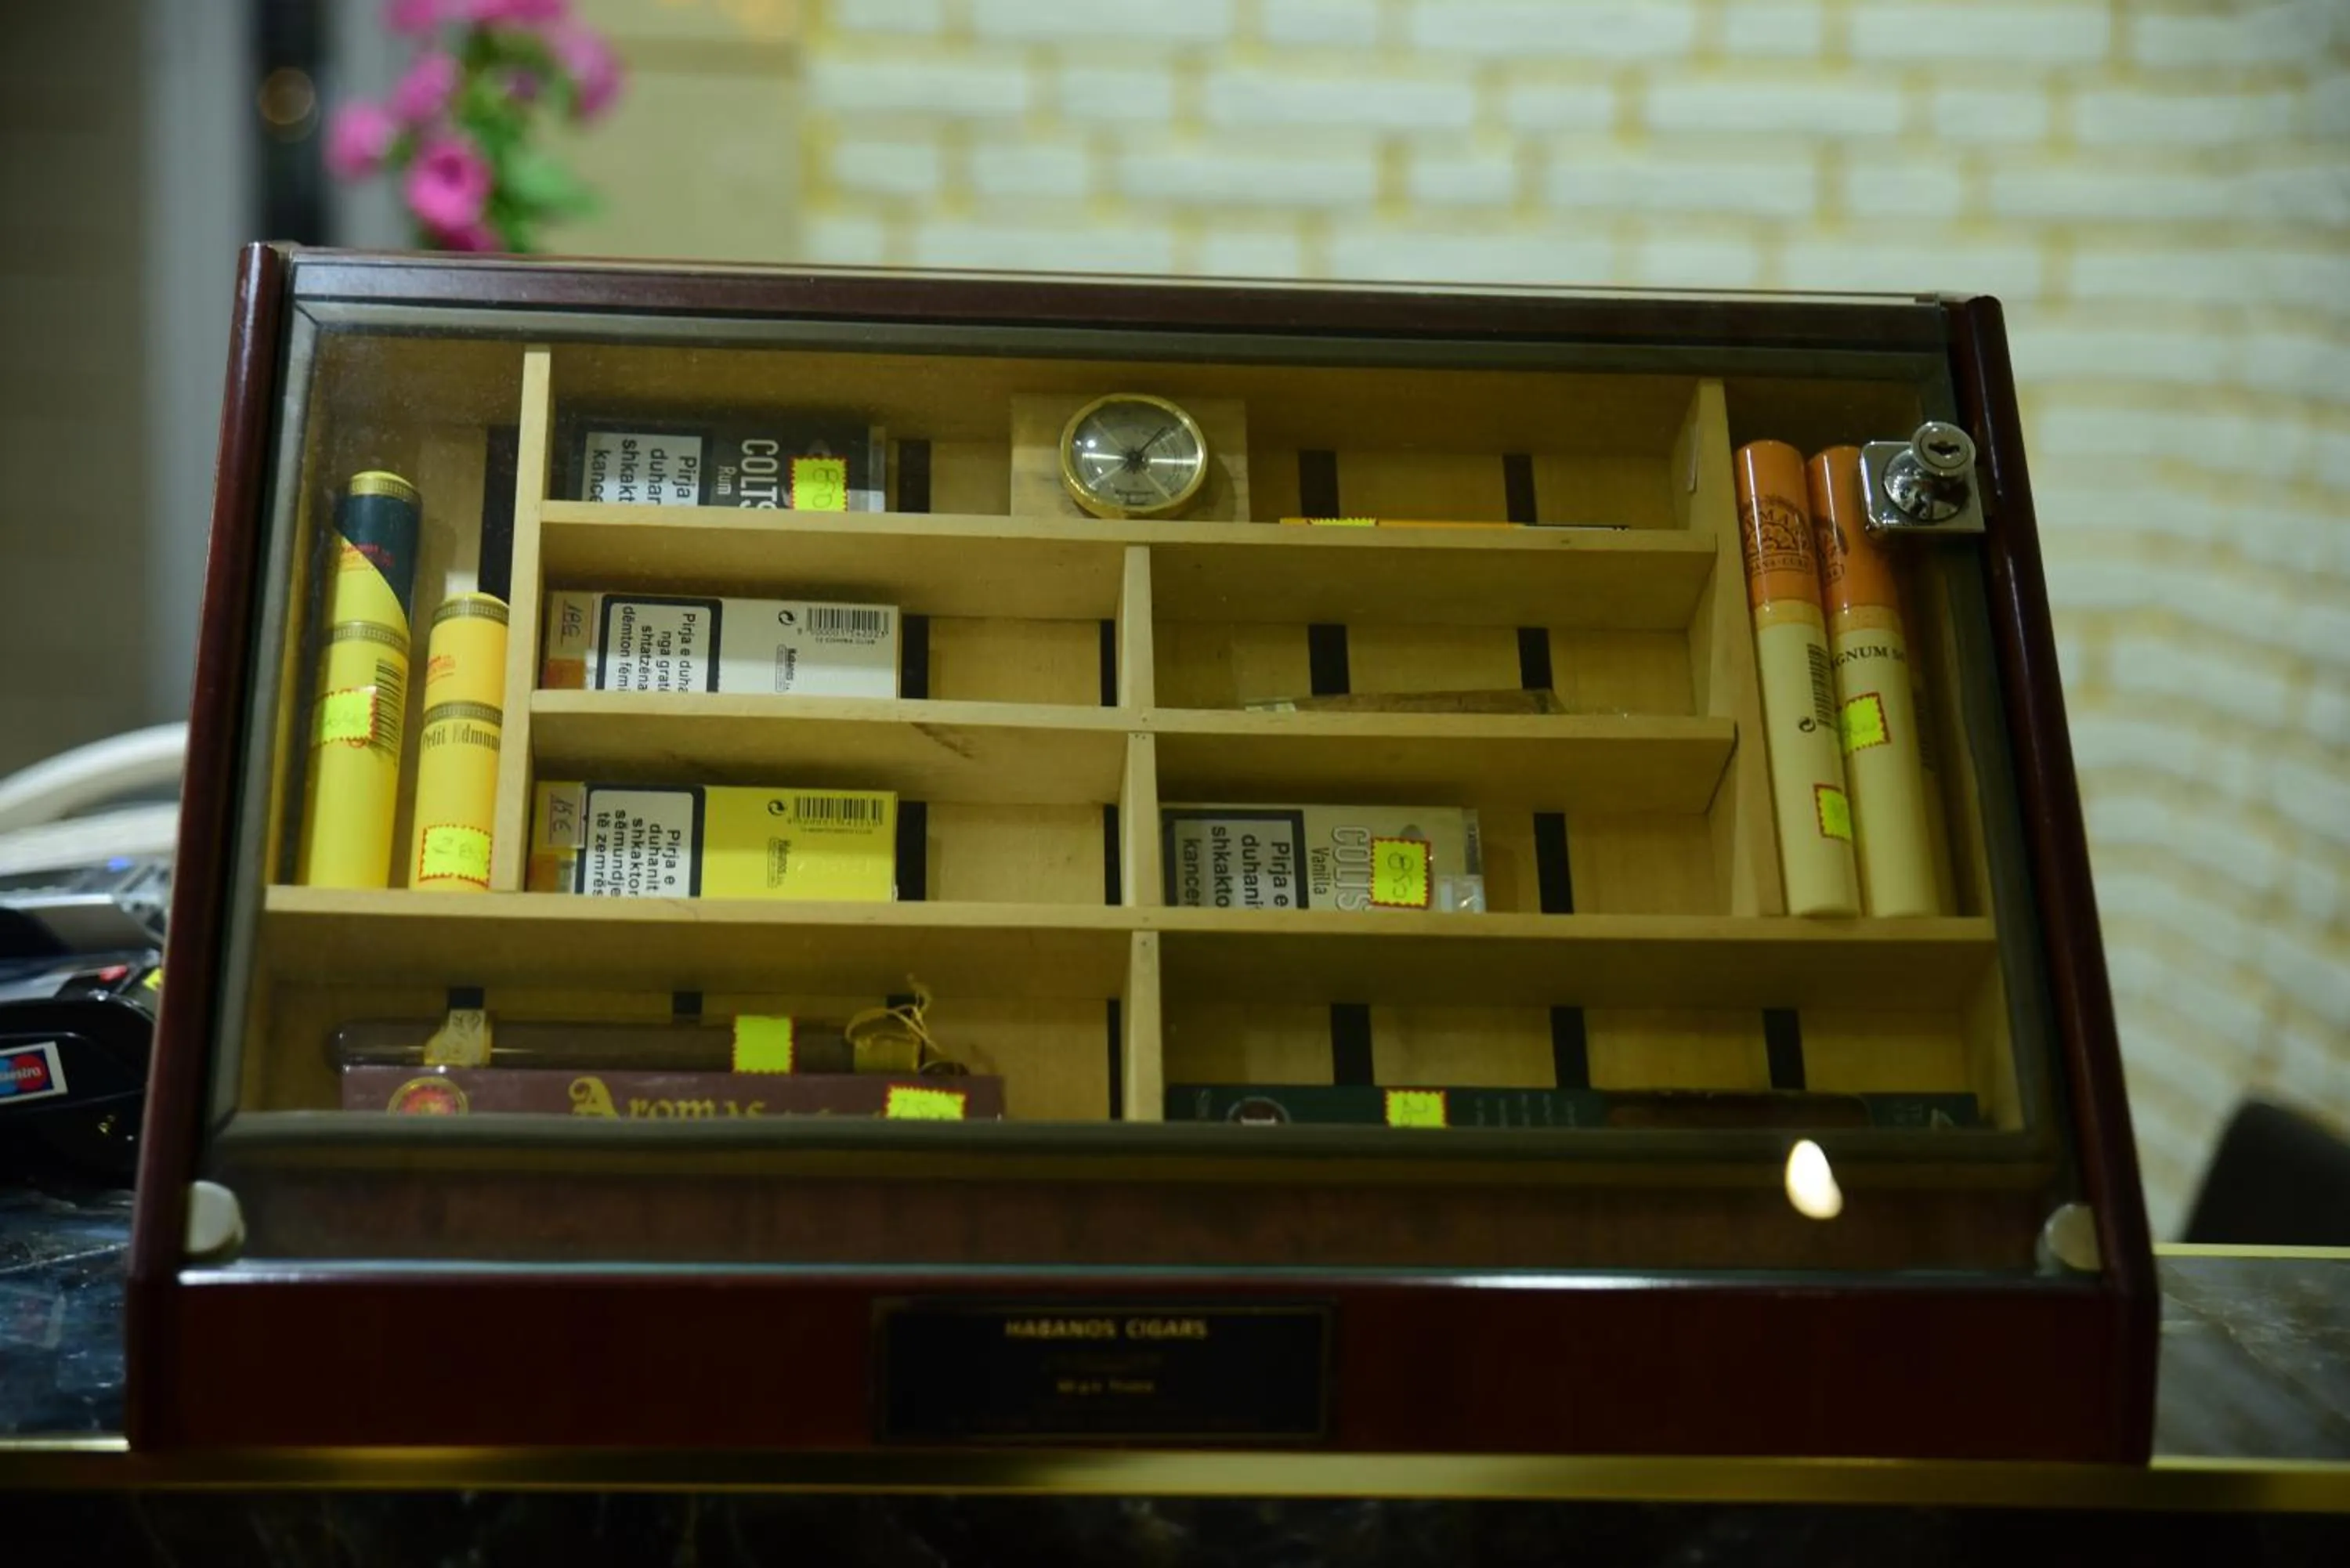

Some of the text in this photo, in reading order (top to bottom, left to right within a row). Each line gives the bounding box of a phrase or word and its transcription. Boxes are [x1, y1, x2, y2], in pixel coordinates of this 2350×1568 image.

[672, 455, 697, 499] Pirja
[716, 465, 738, 496] Rum
[657, 630, 672, 656] nga
[678, 612, 696, 645] Pirja
[679, 648, 691, 657] e
[596, 811, 610, 828] të
[646, 823, 663, 891] duhanit
[662, 829, 682, 886] Pirja e
[1242, 834, 1264, 909] duhani
[1267, 840, 1292, 907] Pirja e
[1311, 847, 1329, 895] Vanilla
[1332, 826, 1372, 912] COLTS
